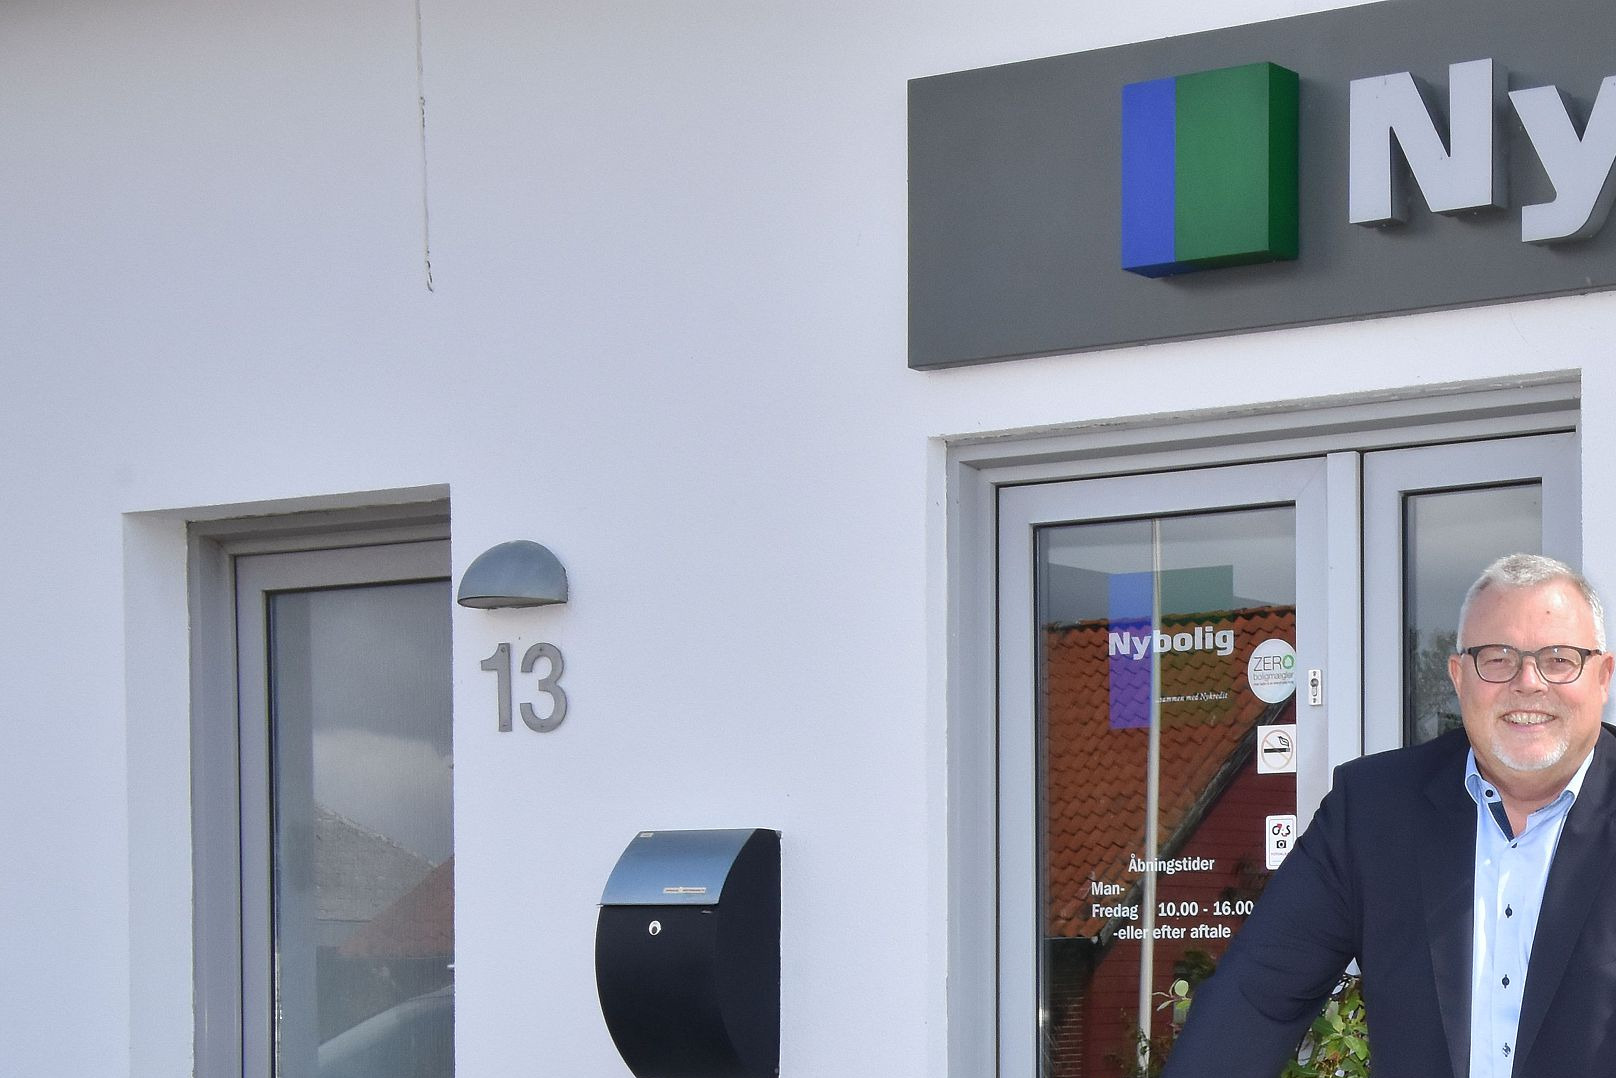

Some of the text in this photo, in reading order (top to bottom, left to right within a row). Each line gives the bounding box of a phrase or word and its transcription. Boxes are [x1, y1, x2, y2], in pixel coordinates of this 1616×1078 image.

[1108, 626, 1235, 660] Nybolig
[1253, 655, 1295, 672] ZERO
[480, 641, 569, 734] 13
[1127, 853, 1215, 875] Åbningstider
[1091, 881, 1126, 896] Man-
[1091, 903, 1139, 921] Fredag
[1158, 901, 1199, 917] 10.00
[1212, 900, 1254, 916] 16.00
[1112, 924, 1232, 940] -eller efter aftale
